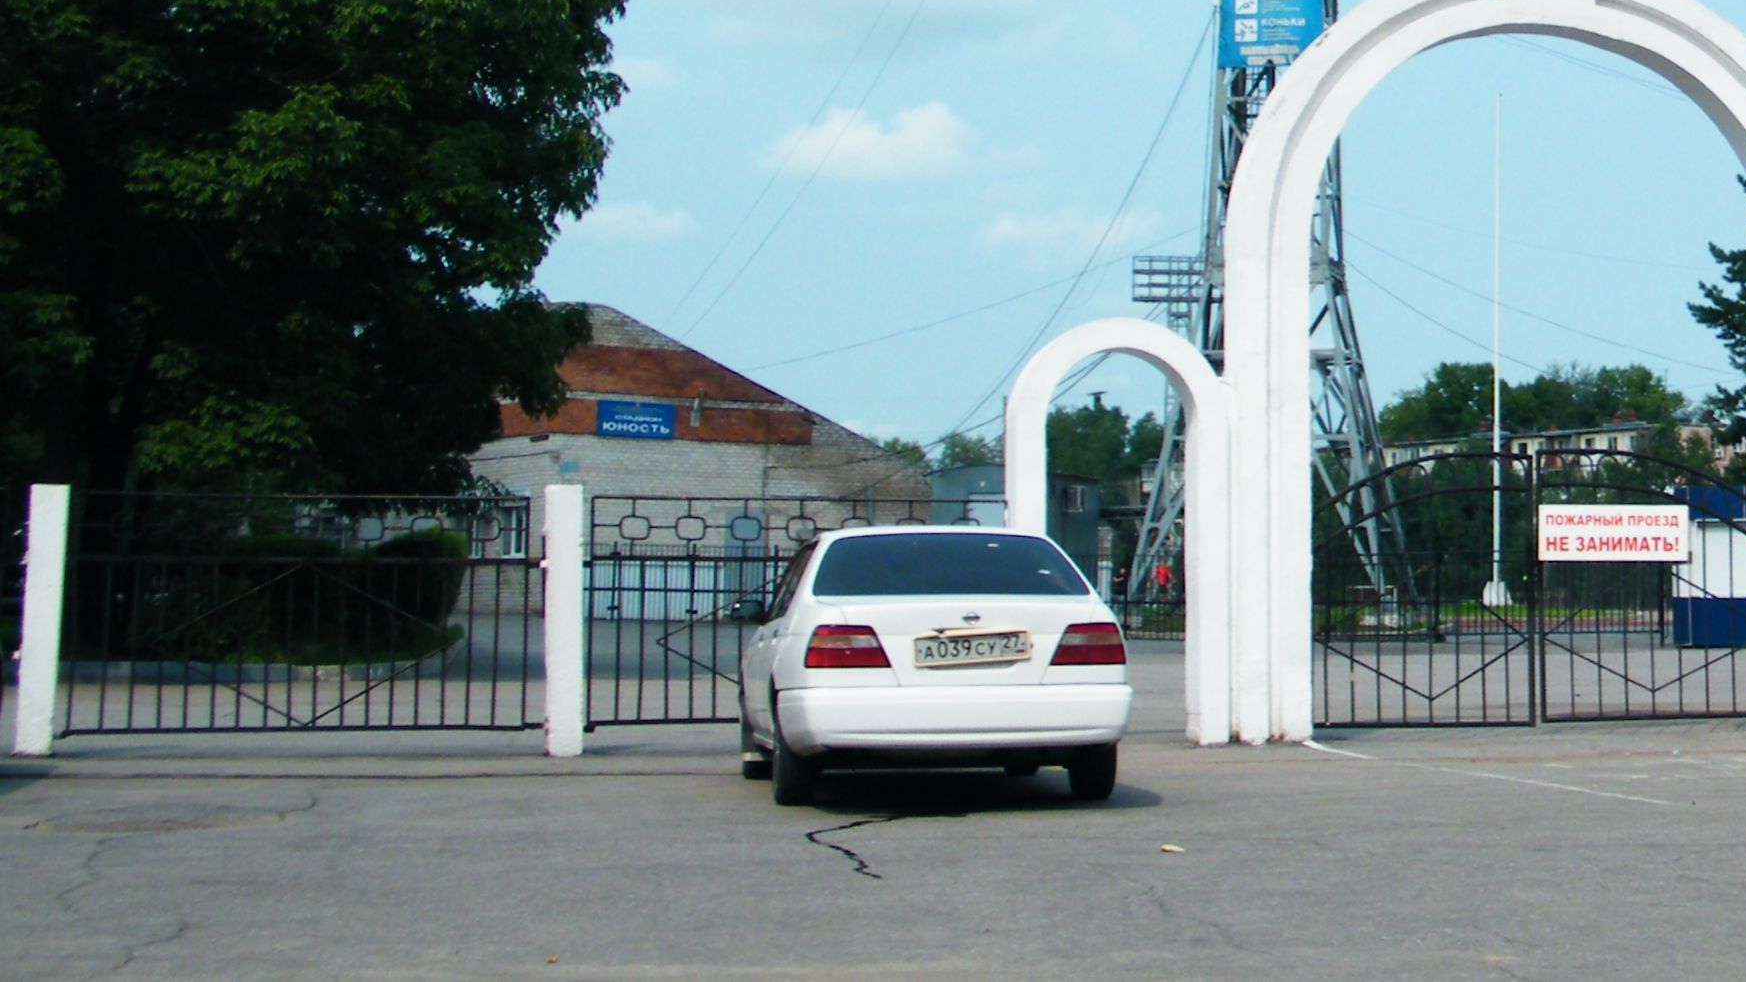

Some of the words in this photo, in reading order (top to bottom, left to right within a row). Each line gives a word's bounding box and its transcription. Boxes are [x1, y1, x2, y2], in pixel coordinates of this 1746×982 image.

[603, 421, 670, 434] ЮНОСТЬ
[1546, 514, 1623, 526] ПОЖАРНЫЙ
[1628, 515, 1679, 527] ПРОЕЗД
[1545, 536, 1569, 552] НЕ
[1575, 536, 1680, 552] ЗАНИМАТЬ!
